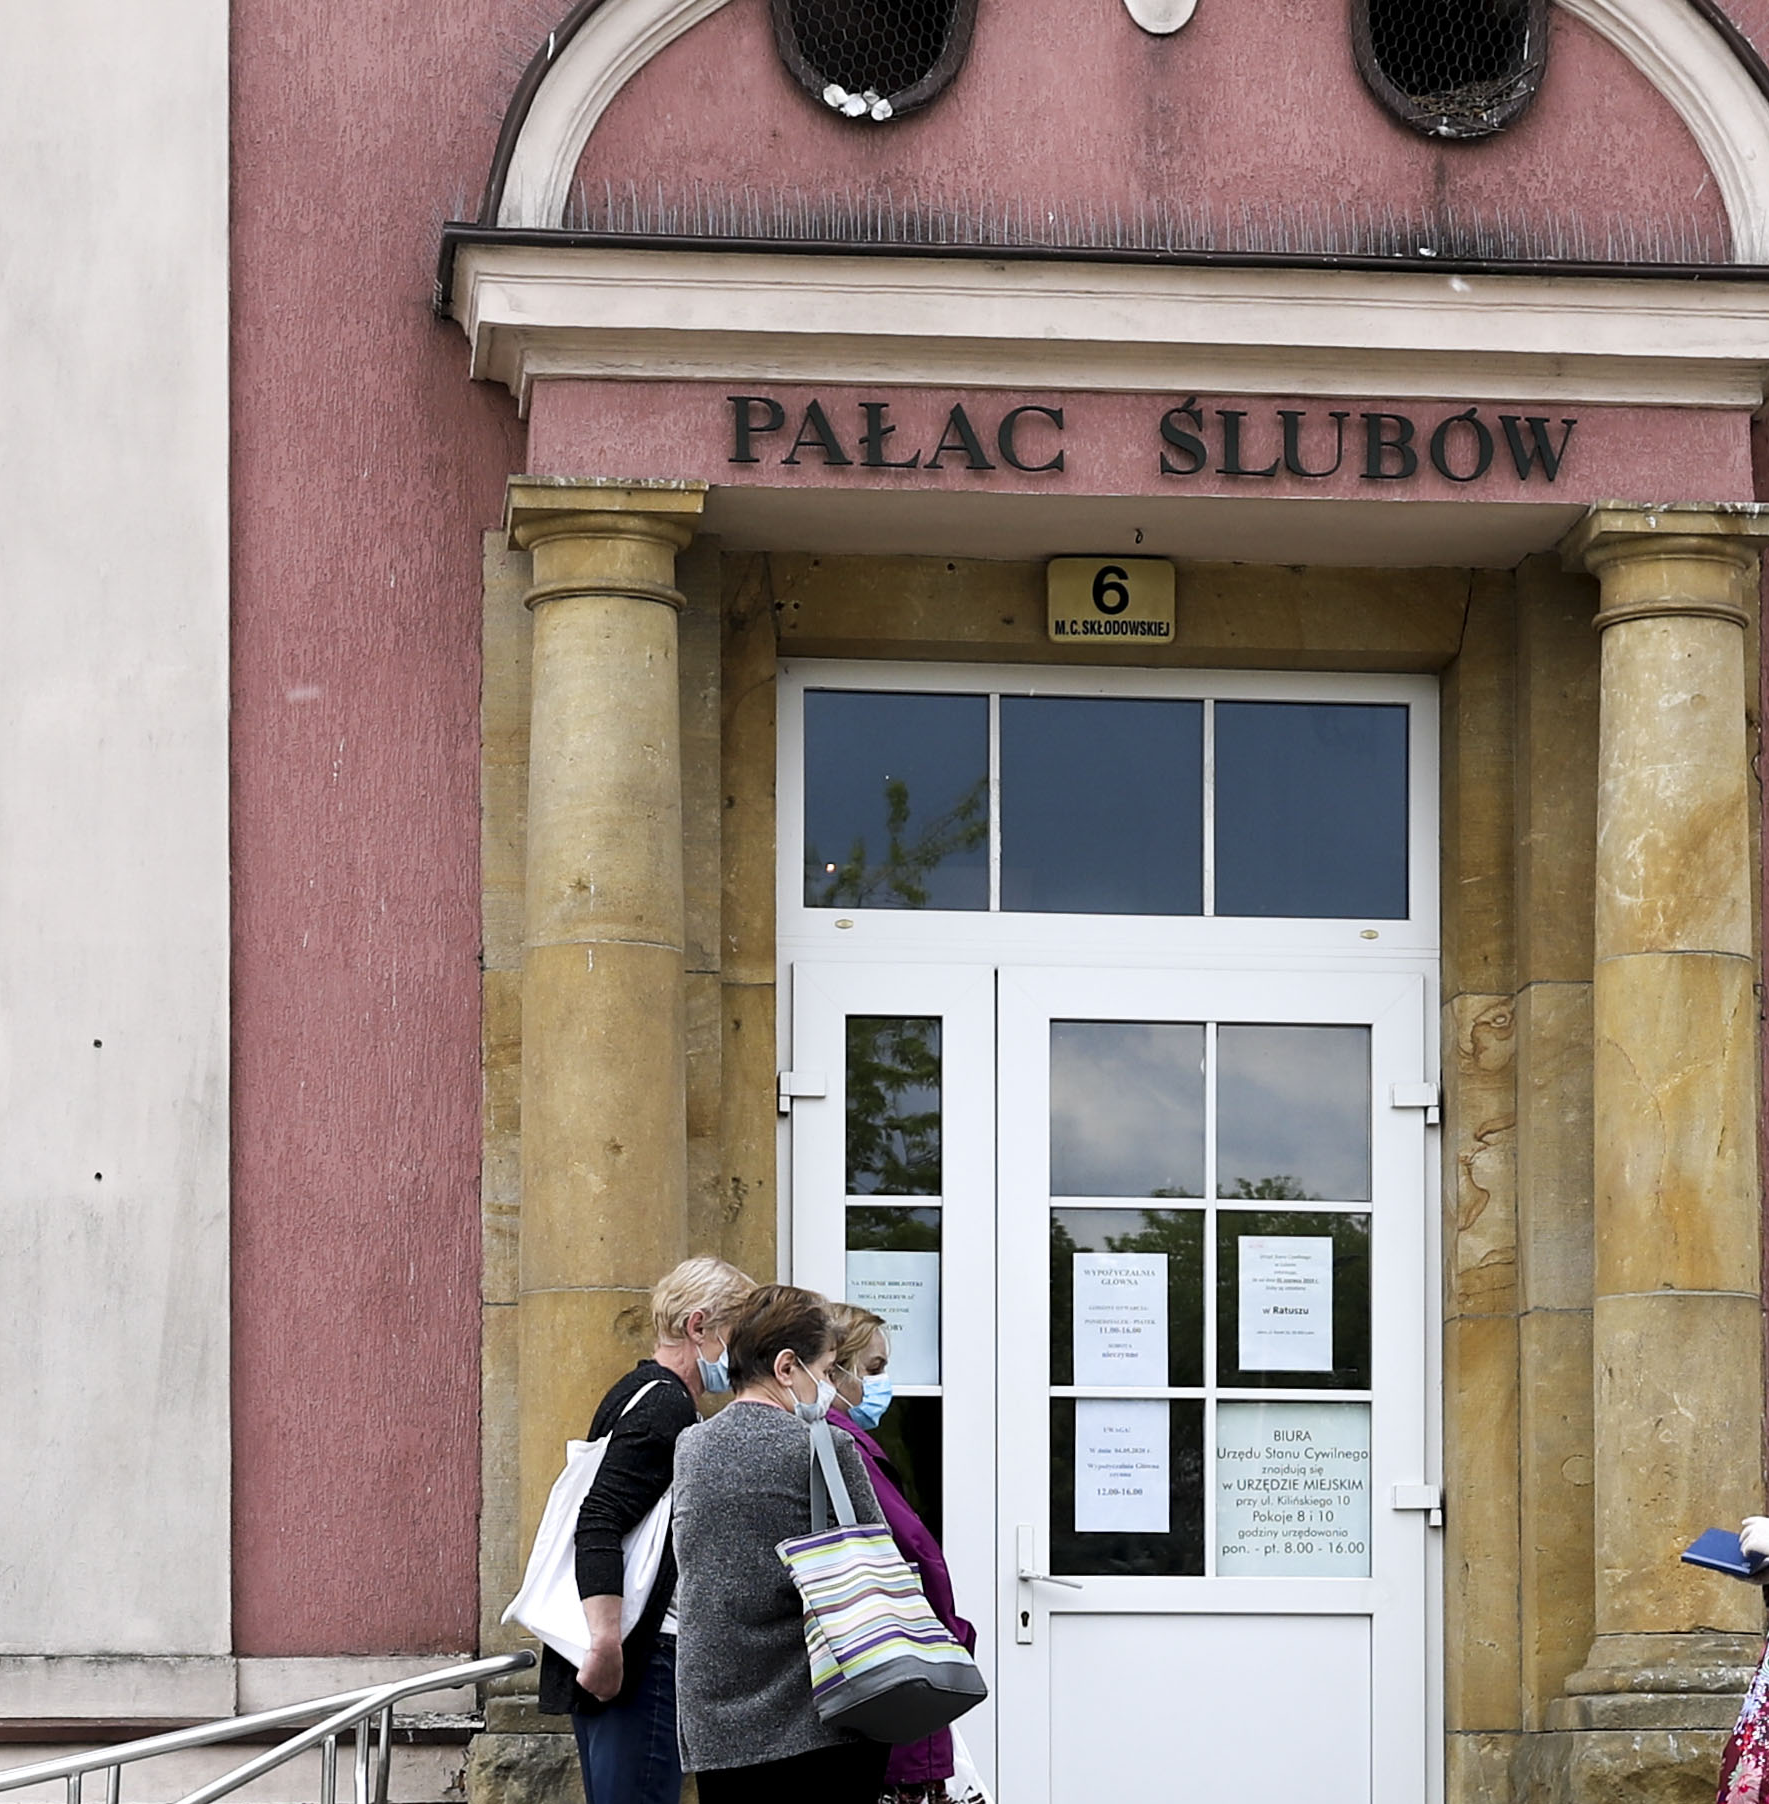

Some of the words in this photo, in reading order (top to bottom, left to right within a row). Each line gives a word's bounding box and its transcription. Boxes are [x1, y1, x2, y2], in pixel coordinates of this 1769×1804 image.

[726, 395, 1065, 473] PAŁAC
[1159, 396, 1578, 483] ŚLUBÓW
[1092, 565, 1130, 616] 6
[1272, 1305, 1309, 1315] Ratuszu
[1273, 1430, 1312, 1442] BIURA
[1216, 1447, 1261, 1461] Urzędu
[1265, 1447, 1300, 1460] Stanu
[1304, 1447, 1369, 1462] Cywilnego
[1261, 1464, 1307, 1476] znajdują
[1309, 1464, 1324, 1476] się
[1222, 1482, 1232, 1491] w
[1236, 1478, 1300, 1493] URZĘDZIE
[1303, 1479, 1364, 1491] MIEJSKIM
[1235, 1498, 1258, 1507] przy
[1261, 1496, 1274, 1506] ul.
[1277, 1495, 1333, 1508] Kilińskiego
[1337, 1495, 1351, 1506] 10
[1252, 1510, 1293, 1524] Pokoje
[1297, 1511, 1305, 1522] 8
[1319, 1511, 1334, 1522] 10
[1237, 1527, 1278, 1539] godziny
[1281, 1527, 1349, 1539] urzędowania
[1222, 1544, 1250, 1557] pon.
[1264, 1543, 1279, 1556] pt.
[1284, 1542, 1314, 1554] 8.00
[1329, 1542, 1365, 1554] 16.00
